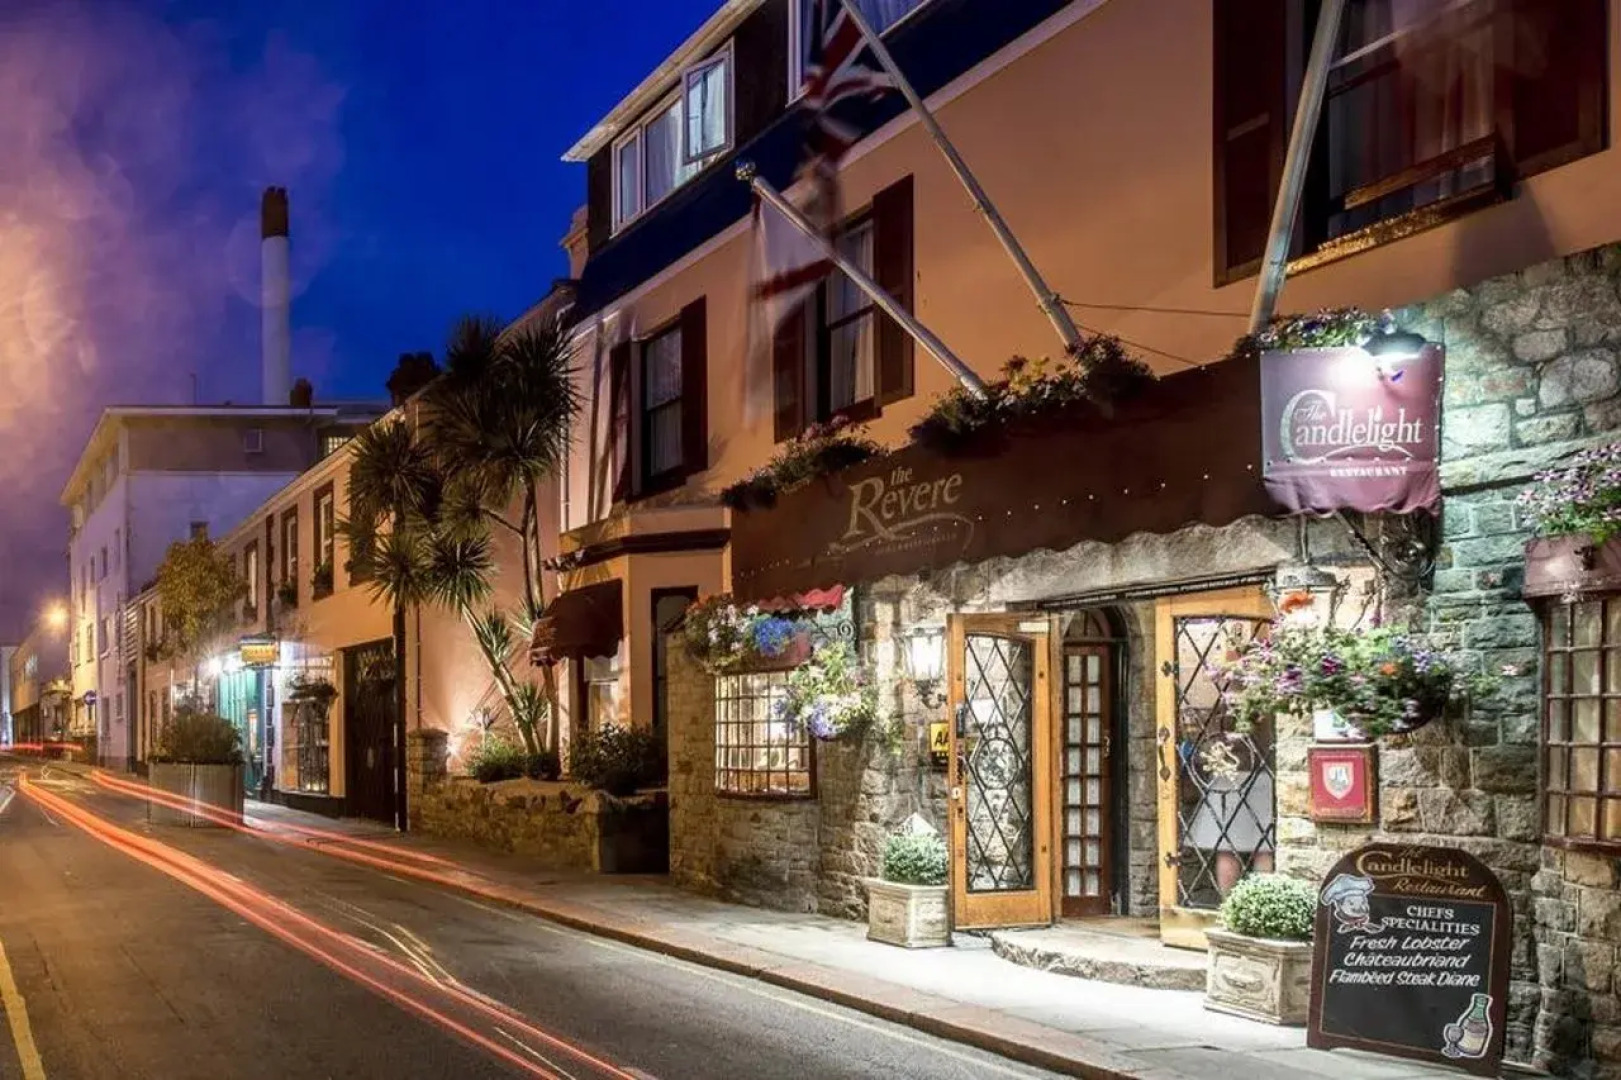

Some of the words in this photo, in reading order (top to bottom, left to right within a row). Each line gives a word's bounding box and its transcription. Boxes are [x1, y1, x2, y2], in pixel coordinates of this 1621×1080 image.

[1295, 403, 1326, 421] The
[1280, 389, 1424, 464] Candlelight
[890, 466, 912, 486] the
[1330, 466, 1408, 477] RESTAURANT
[842, 473, 962, 540] Revere
[1356, 850, 1470, 879] Candlelight
[1393, 878, 1488, 897] Restaurant
[1381, 916, 1481, 936] SPECIALITIES
[1350, 935, 1398, 950] Fresh
[1401, 936, 1470, 951] Lobster
[1396, 970, 1437, 987] Steak
[1436, 971, 1481, 988] Diane
